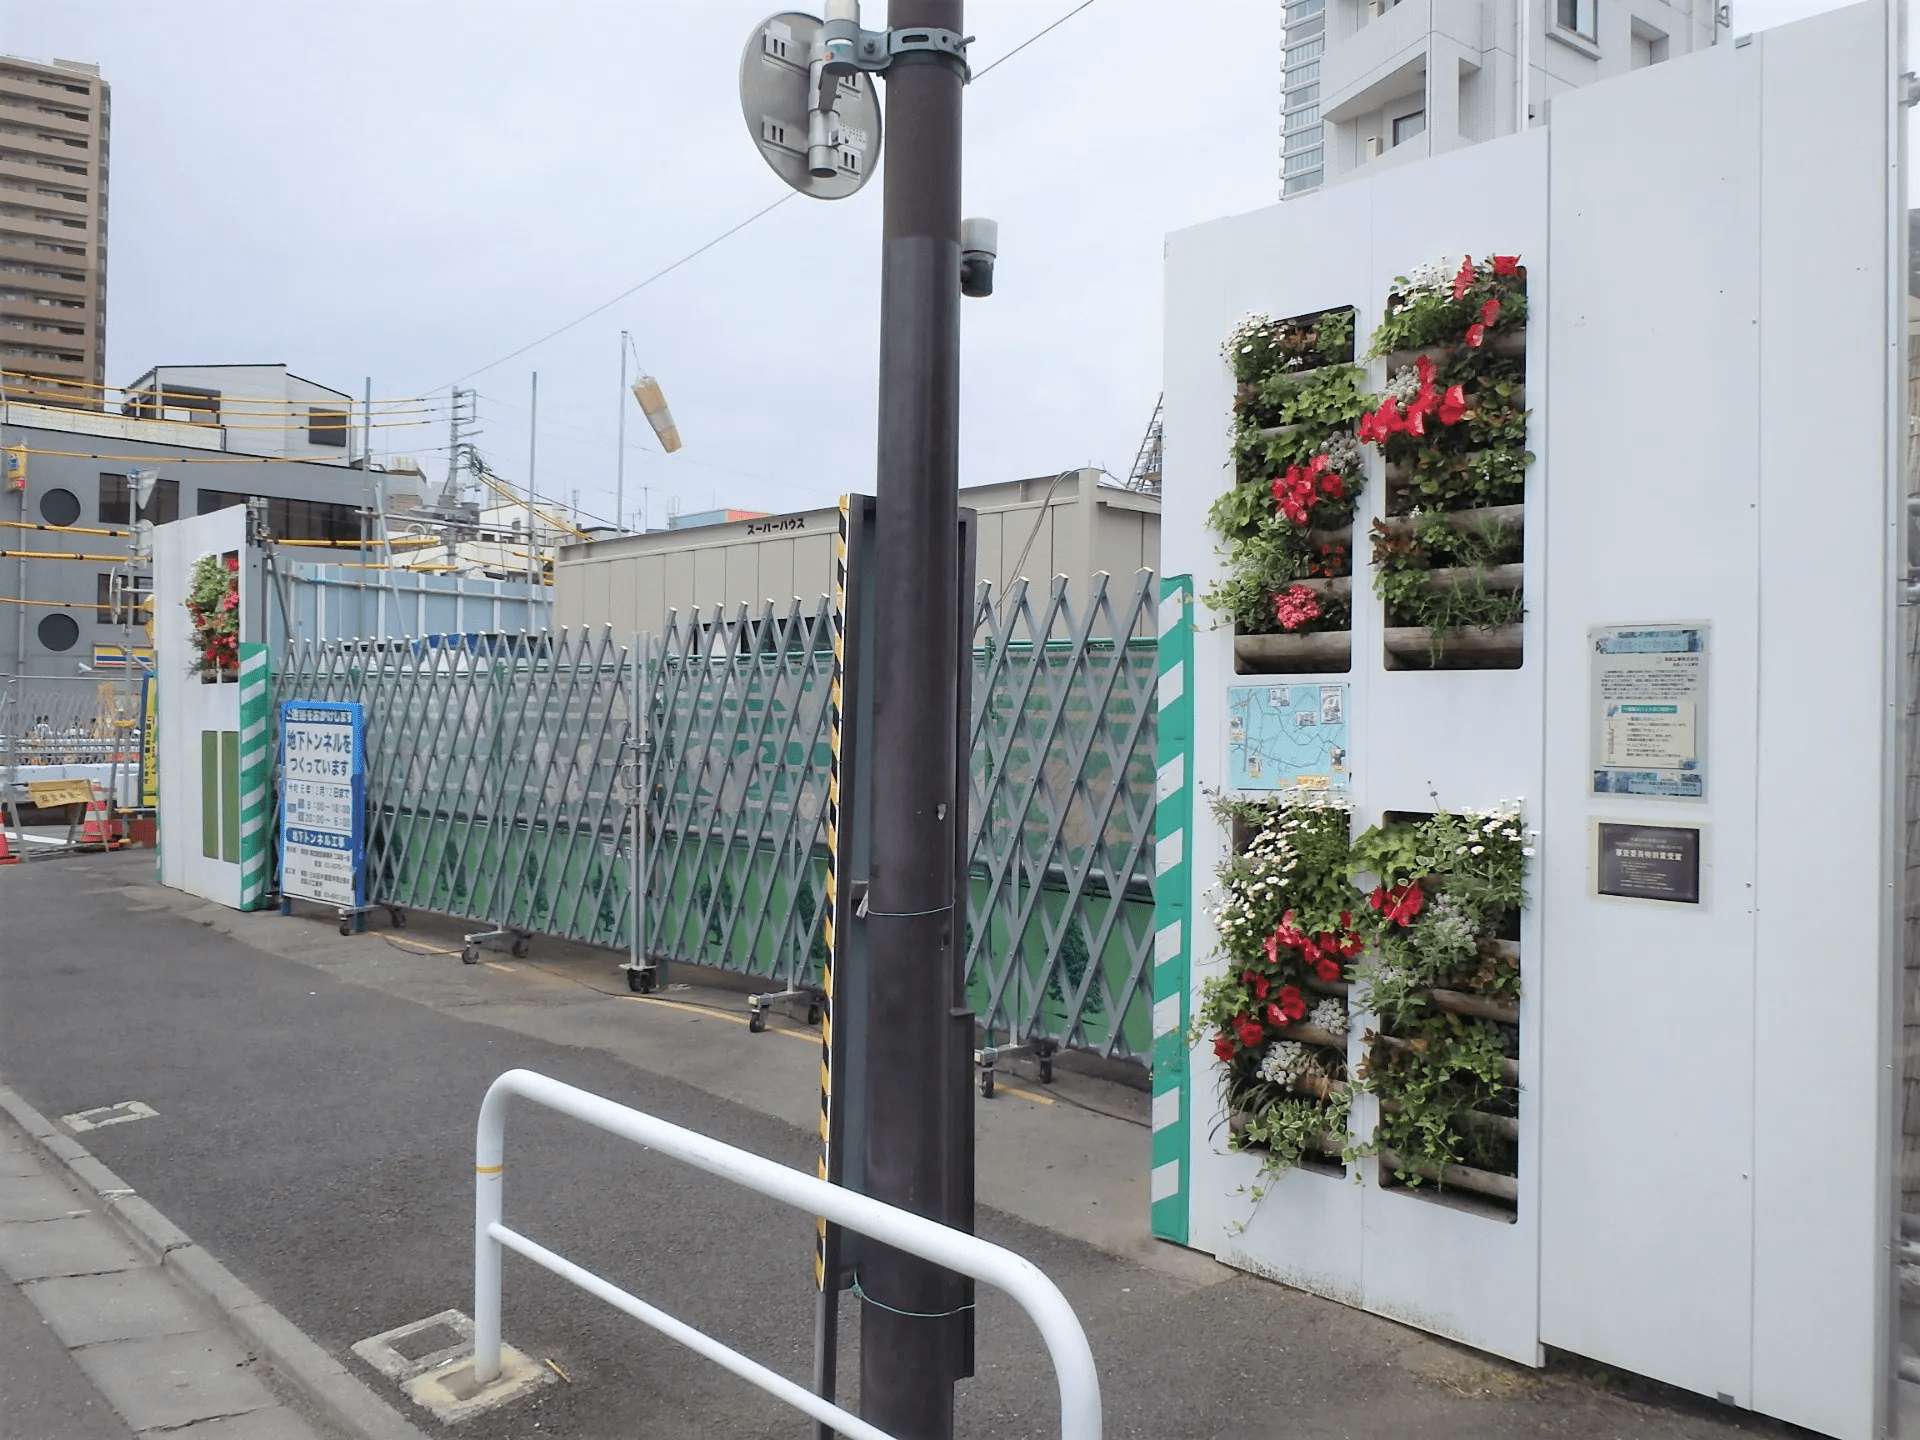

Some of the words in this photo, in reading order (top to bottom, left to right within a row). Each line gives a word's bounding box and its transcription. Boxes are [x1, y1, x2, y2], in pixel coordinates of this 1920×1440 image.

[747, 517, 805, 535] スーパーハウス
[287, 729, 352, 754] 地下トンネルを
[289, 757, 349, 777] つくっています
[292, 830, 346, 848] 地下トンネル工事
